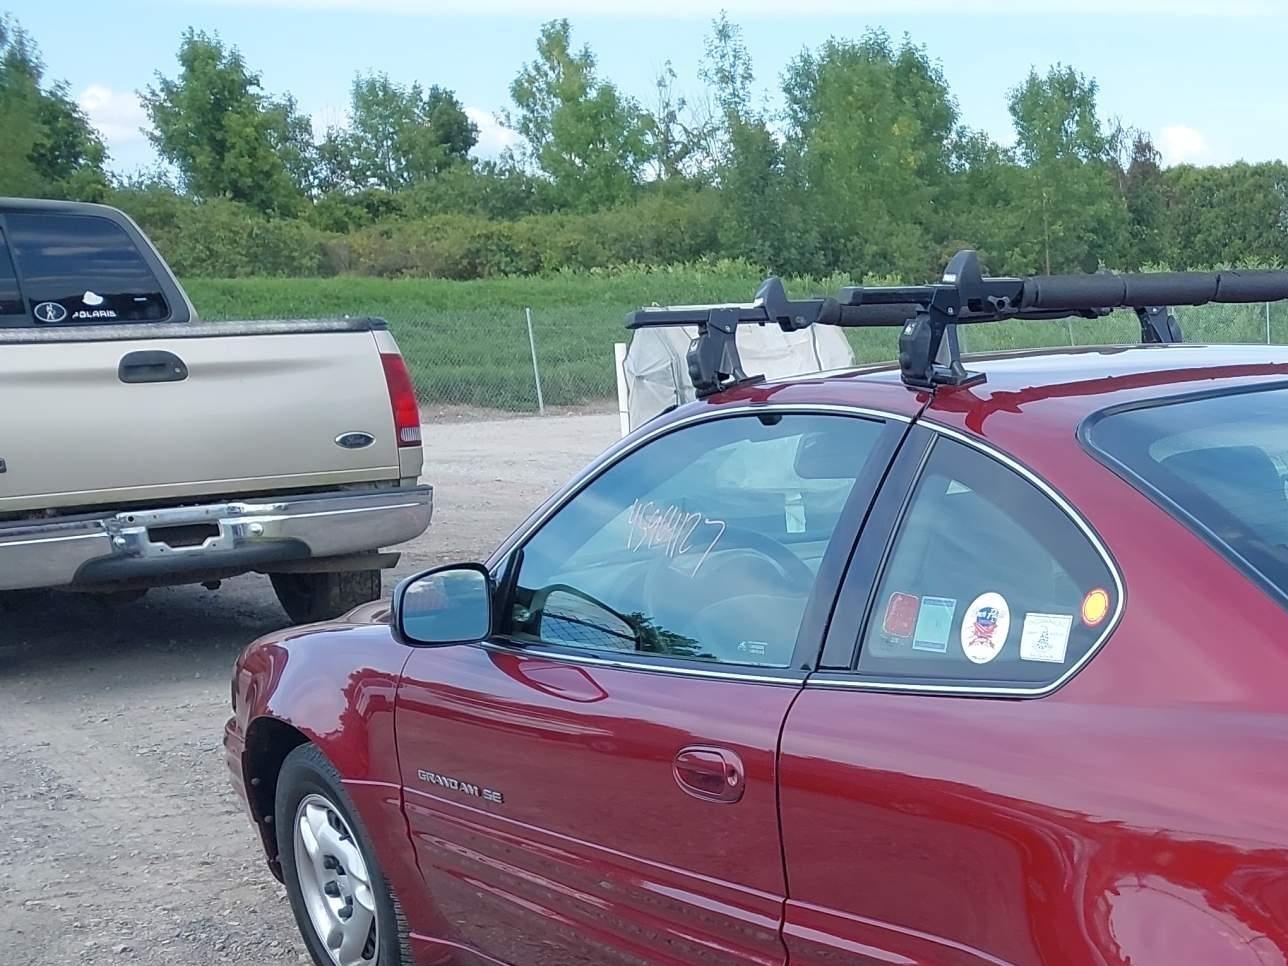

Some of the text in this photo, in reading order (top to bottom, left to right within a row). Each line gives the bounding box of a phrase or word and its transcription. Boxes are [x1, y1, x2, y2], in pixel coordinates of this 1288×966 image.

[417, 769, 502, 804] GRAND AM SE
